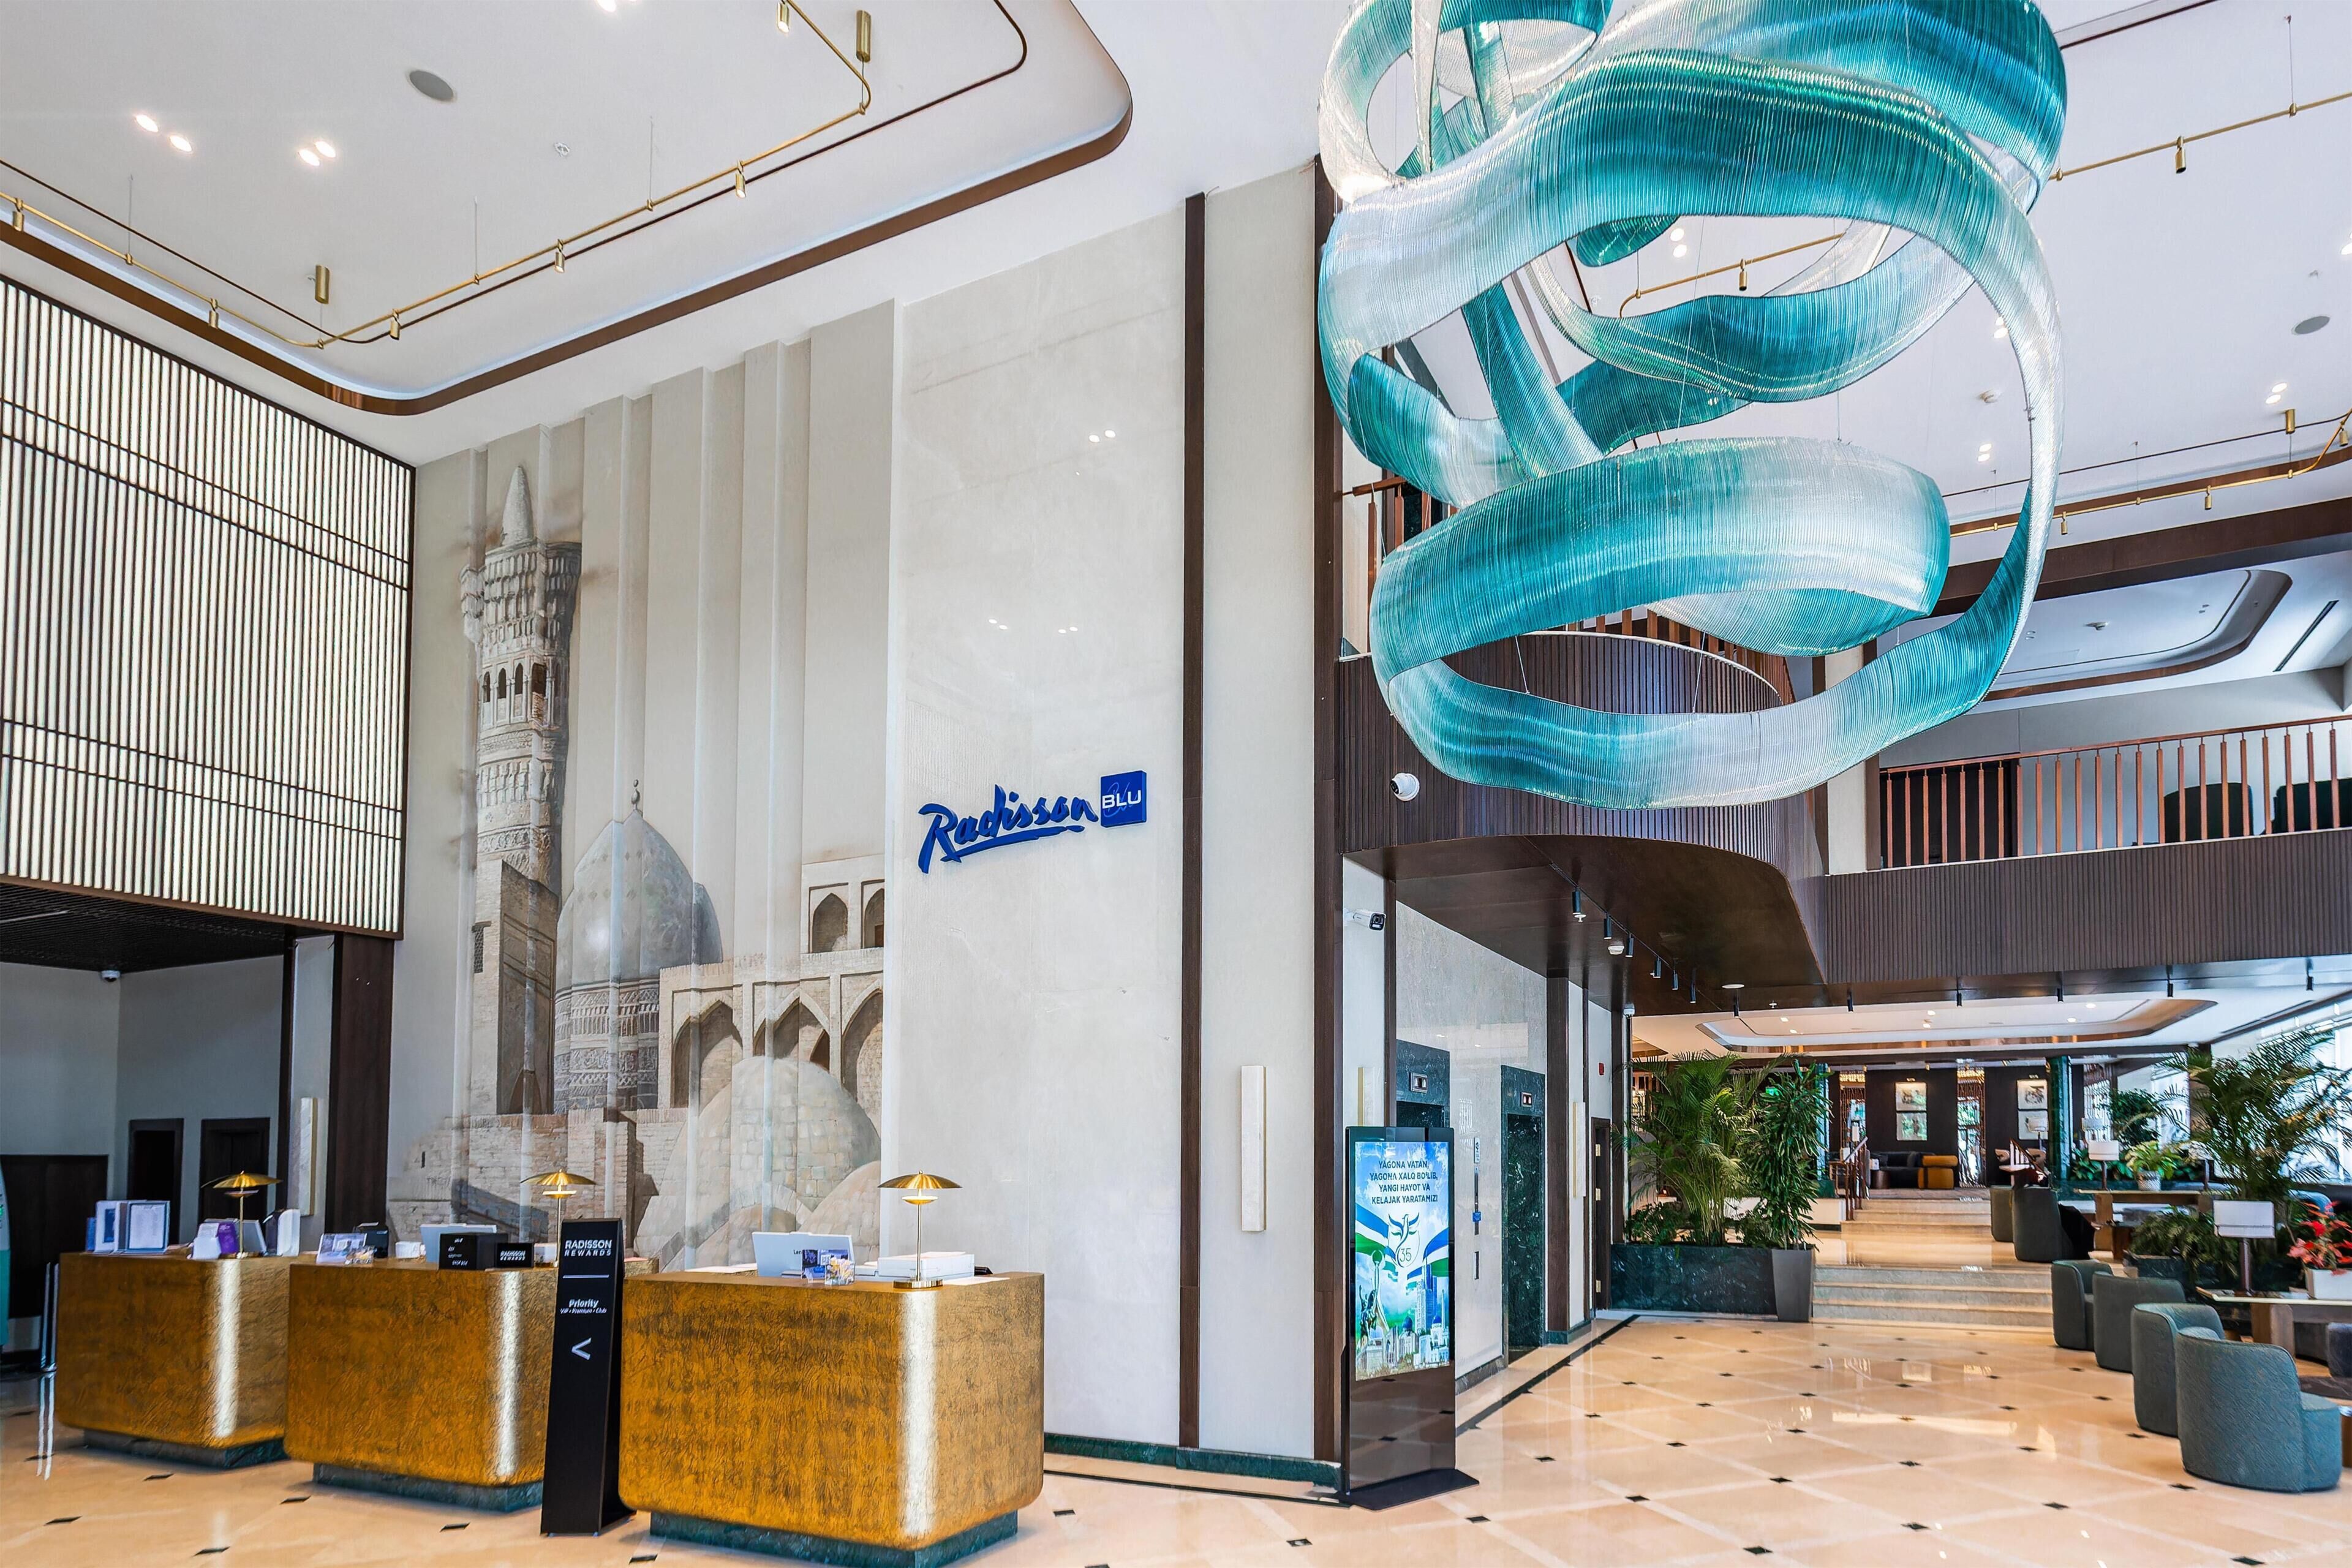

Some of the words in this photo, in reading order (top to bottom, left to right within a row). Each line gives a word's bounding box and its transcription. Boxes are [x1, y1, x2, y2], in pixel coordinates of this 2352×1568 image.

[918, 784, 1099, 873] Radisson
[1102, 790, 1142, 809] BLU
[565, 1239, 612, 1249] RADISSON
[568, 1298, 599, 1308] Priority
